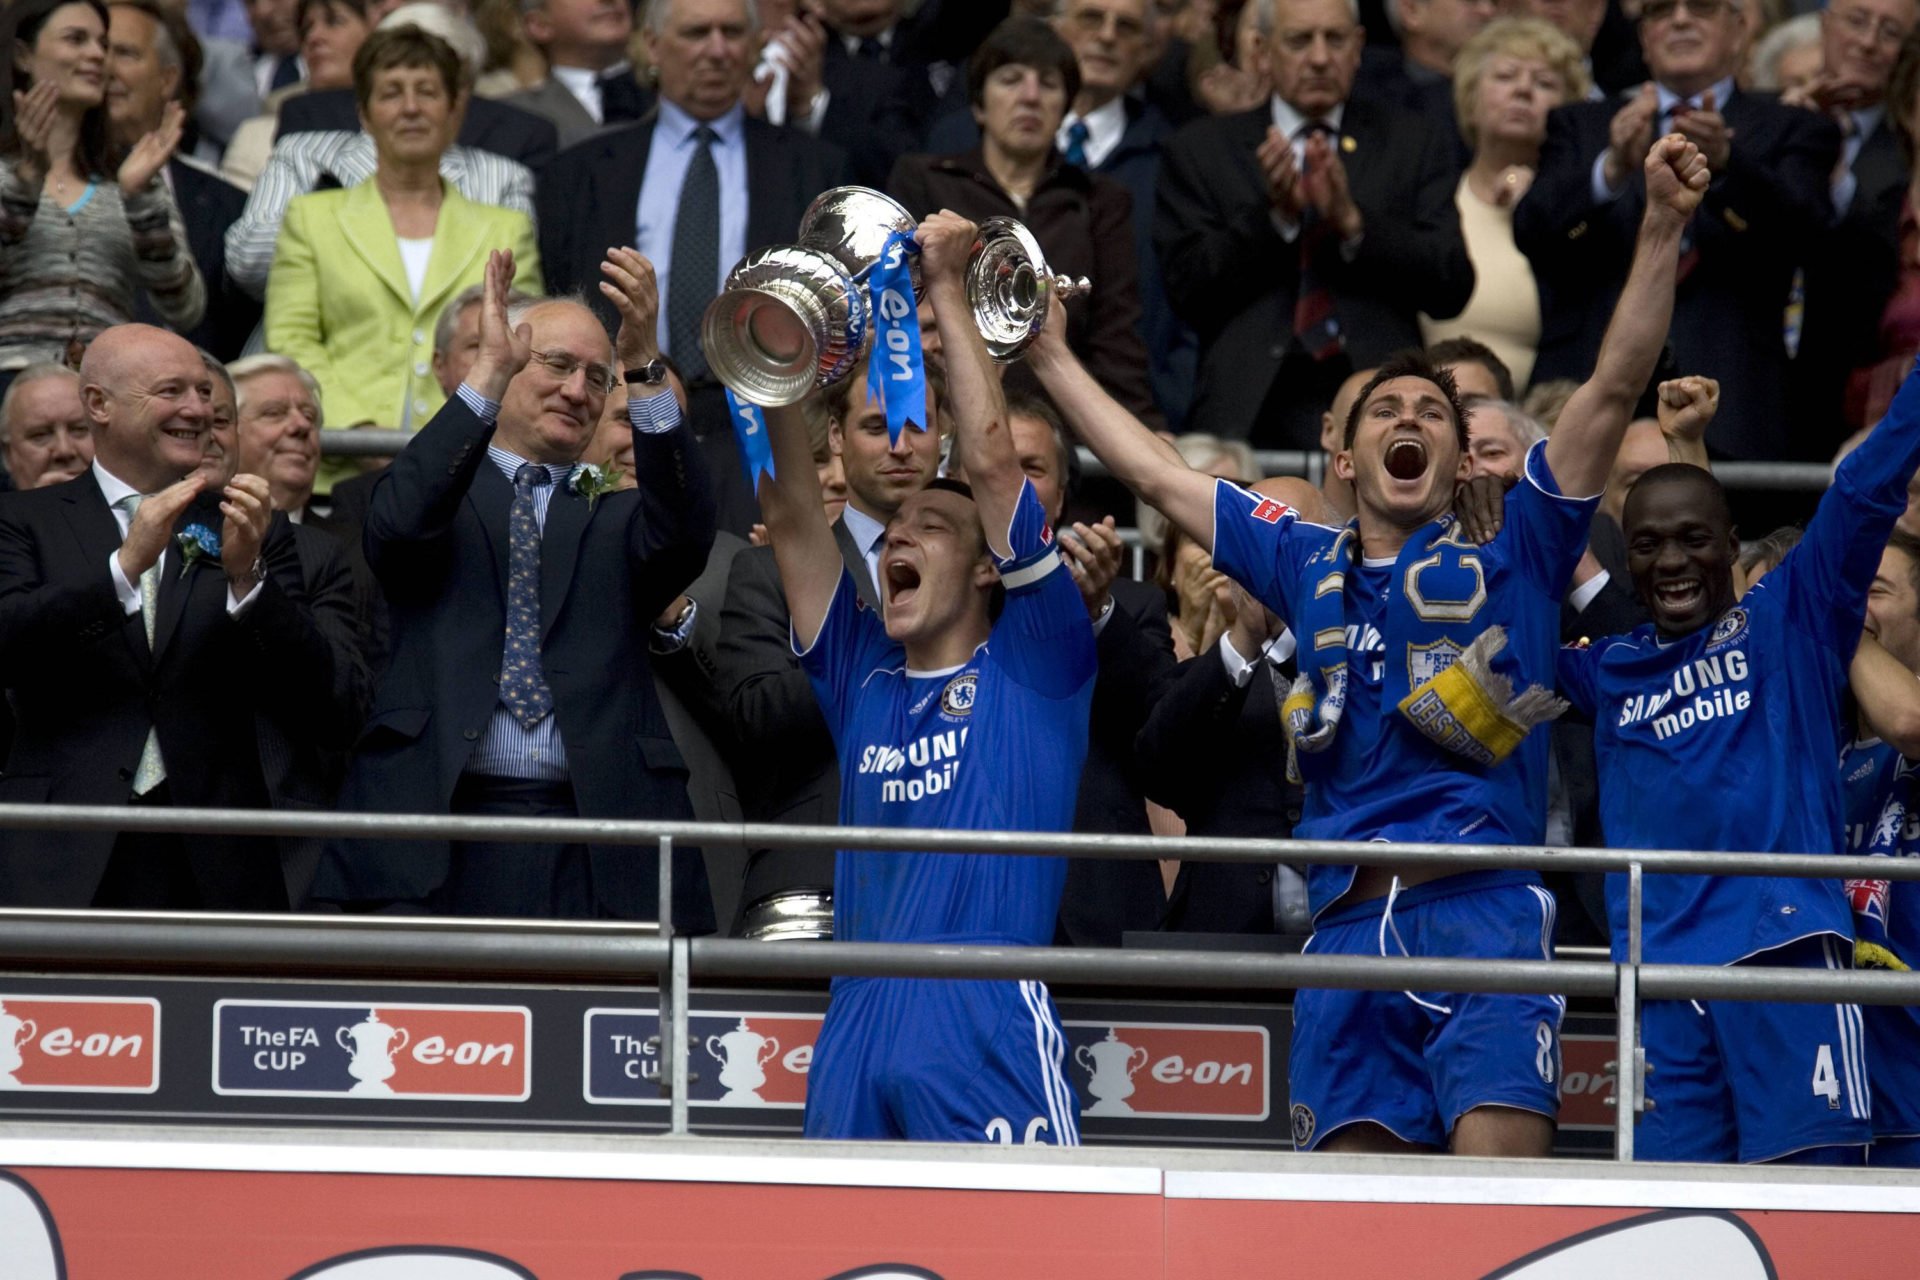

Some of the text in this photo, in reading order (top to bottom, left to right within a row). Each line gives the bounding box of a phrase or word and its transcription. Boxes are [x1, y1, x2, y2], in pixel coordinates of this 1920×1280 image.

[1618, 649, 1749, 727] SAMUNG
[1652, 688, 1751, 740] mobile
[882, 760, 960, 803] mobi
[240, 1026, 320, 1048] The FA
[1535, 1021, 1554, 1084] 8
[253, 1051, 306, 1071] CUP
[624, 1060, 658, 1079] CU
[1812, 1044, 1841, 1110] 4
